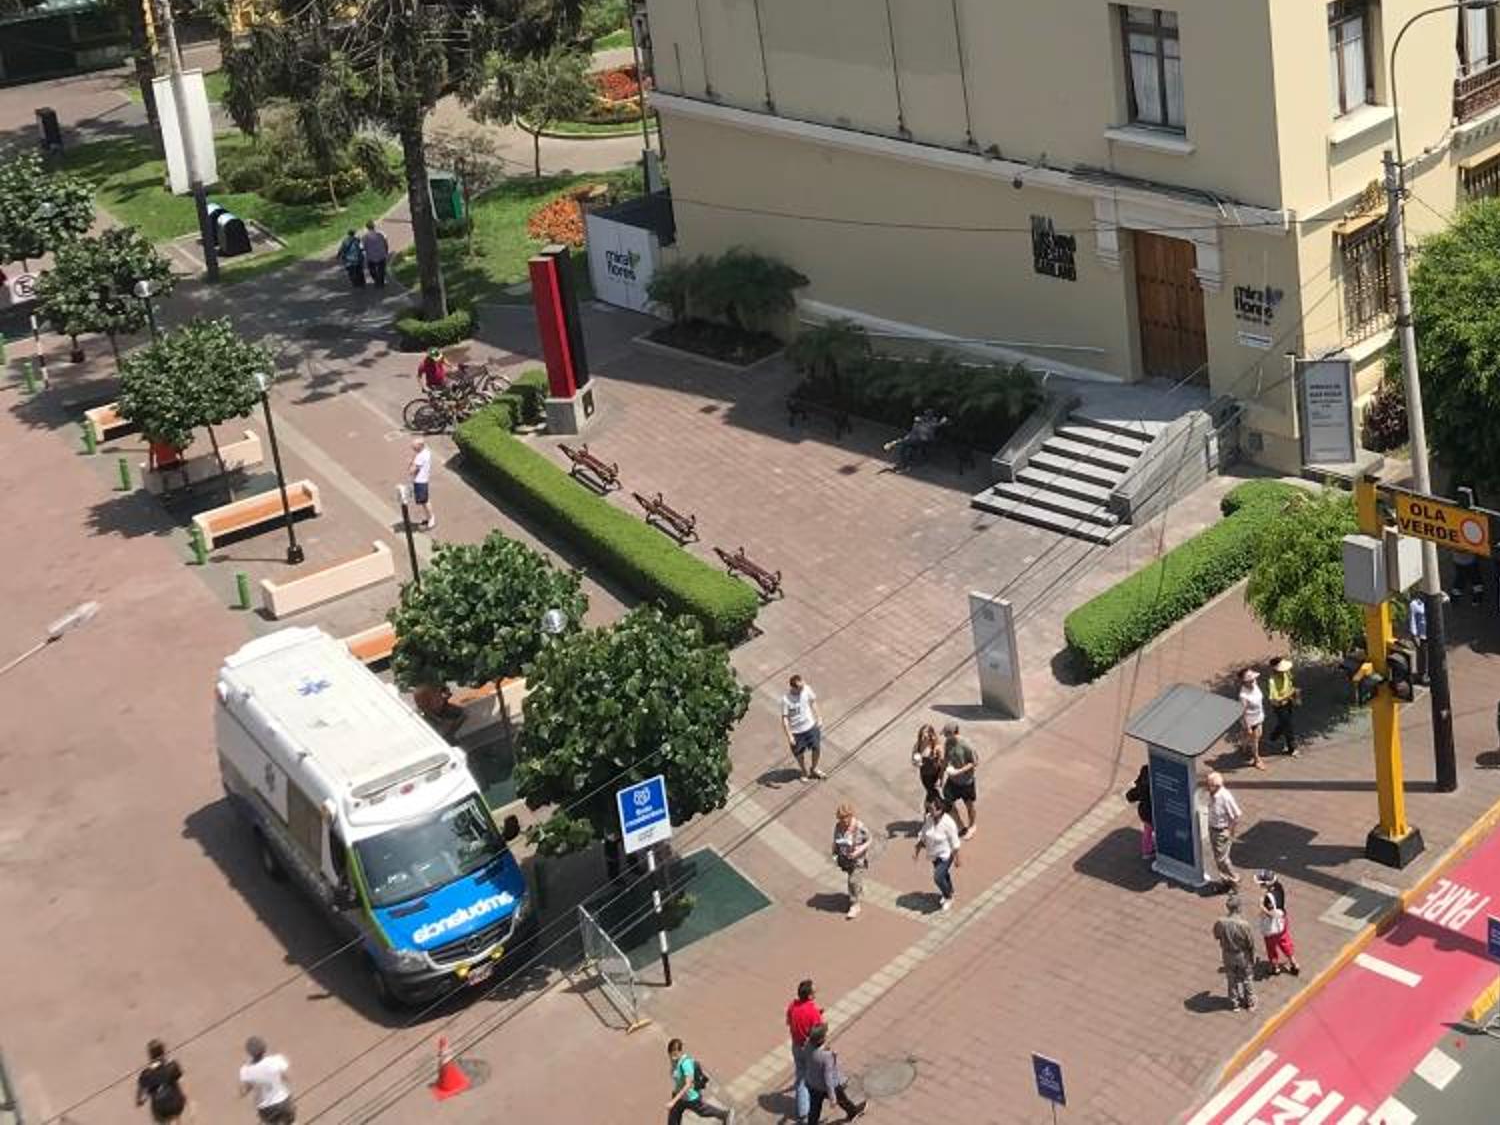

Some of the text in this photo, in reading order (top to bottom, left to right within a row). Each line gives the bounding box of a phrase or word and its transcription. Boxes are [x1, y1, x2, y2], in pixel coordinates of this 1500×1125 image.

[1409, 502, 1447, 521] OLA
[1400, 518, 1458, 543] VERDE
[1408, 878, 1491, 930] PARE
